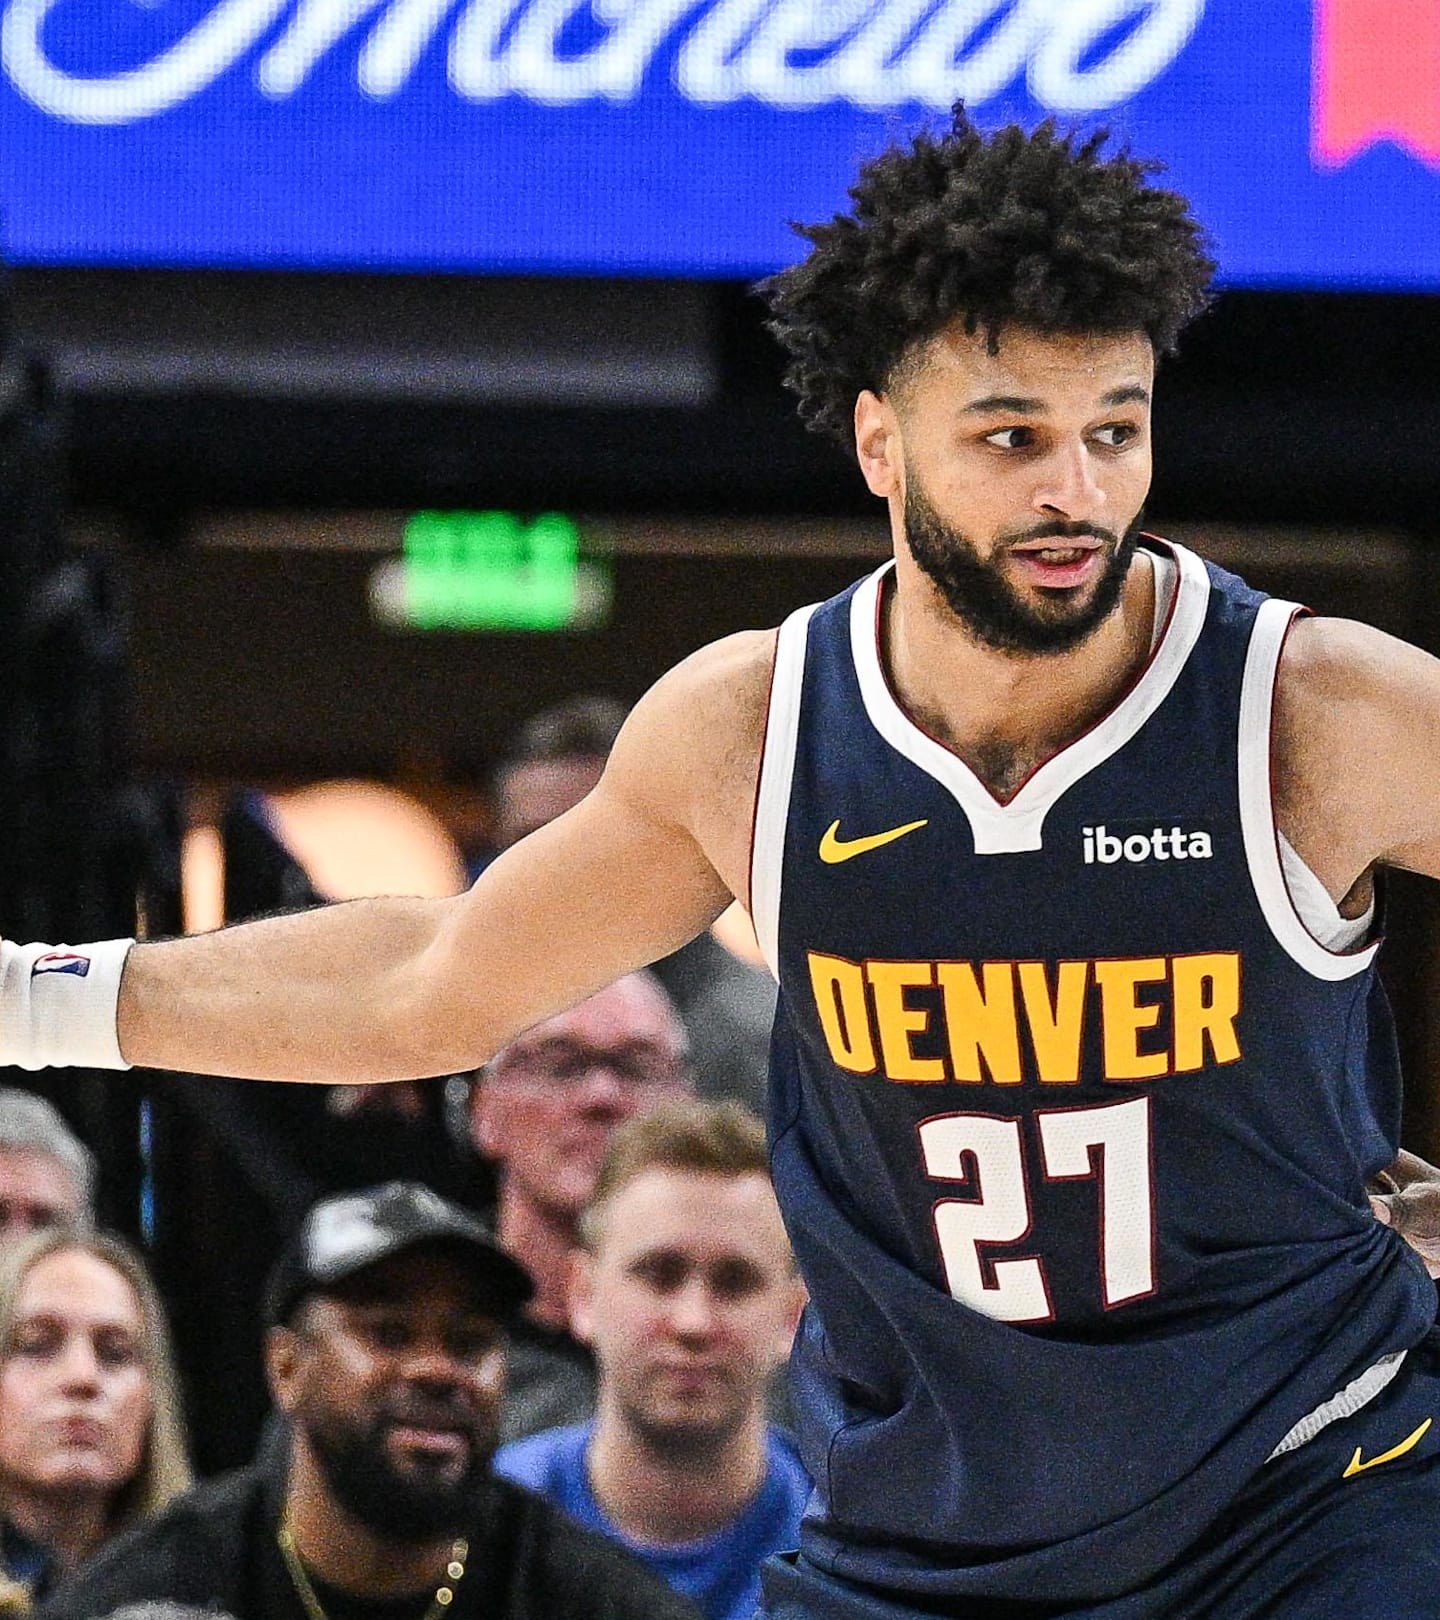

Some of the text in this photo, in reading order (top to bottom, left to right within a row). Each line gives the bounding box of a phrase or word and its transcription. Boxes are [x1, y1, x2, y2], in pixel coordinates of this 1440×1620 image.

[1082, 826, 1213, 863] ibotta
[807, 951, 1242, 1086] DENVER
[917, 1097, 1158, 1322] 27
